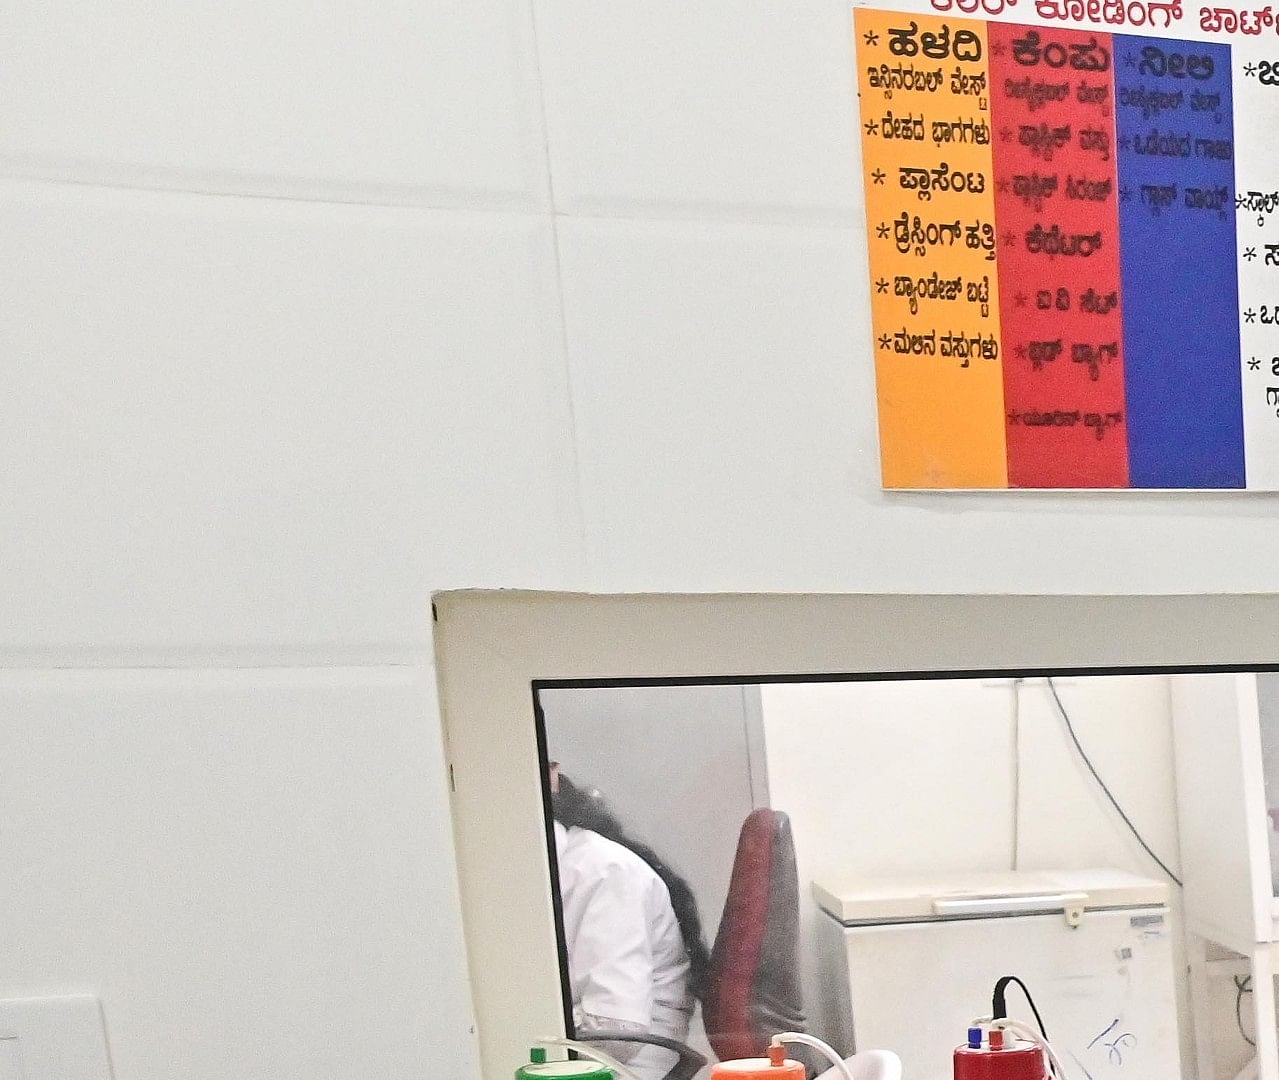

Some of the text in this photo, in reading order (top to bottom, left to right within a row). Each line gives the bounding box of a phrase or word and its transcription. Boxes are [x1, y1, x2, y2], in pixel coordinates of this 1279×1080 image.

[888, 20, 982, 62] ಹಳದಿ
[1012, 30, 1110, 72] ಕೆಂಪು
[1138, 45, 1214, 80] ನೀಲಿ
[951, 66, 987, 111] ವೇಸ್ಟ್
[882, 110, 990, 148] ದೇಹದ ಭಾಗಗಳು
[899, 162, 985, 201] ಪ್ಲಾಸೆಂಟ
[894, 211, 996, 261] ಡ್ರೆಸ್ಸಿಂಗ್ ಹತ್ತಿ
[894, 271, 989, 317] ಬ್ಯಾಂಡೇಜ್ ಬಟ್ಟೆ
[894, 326, 998, 368] ಮಲಿನ ವಸ್ತುಗಳು
